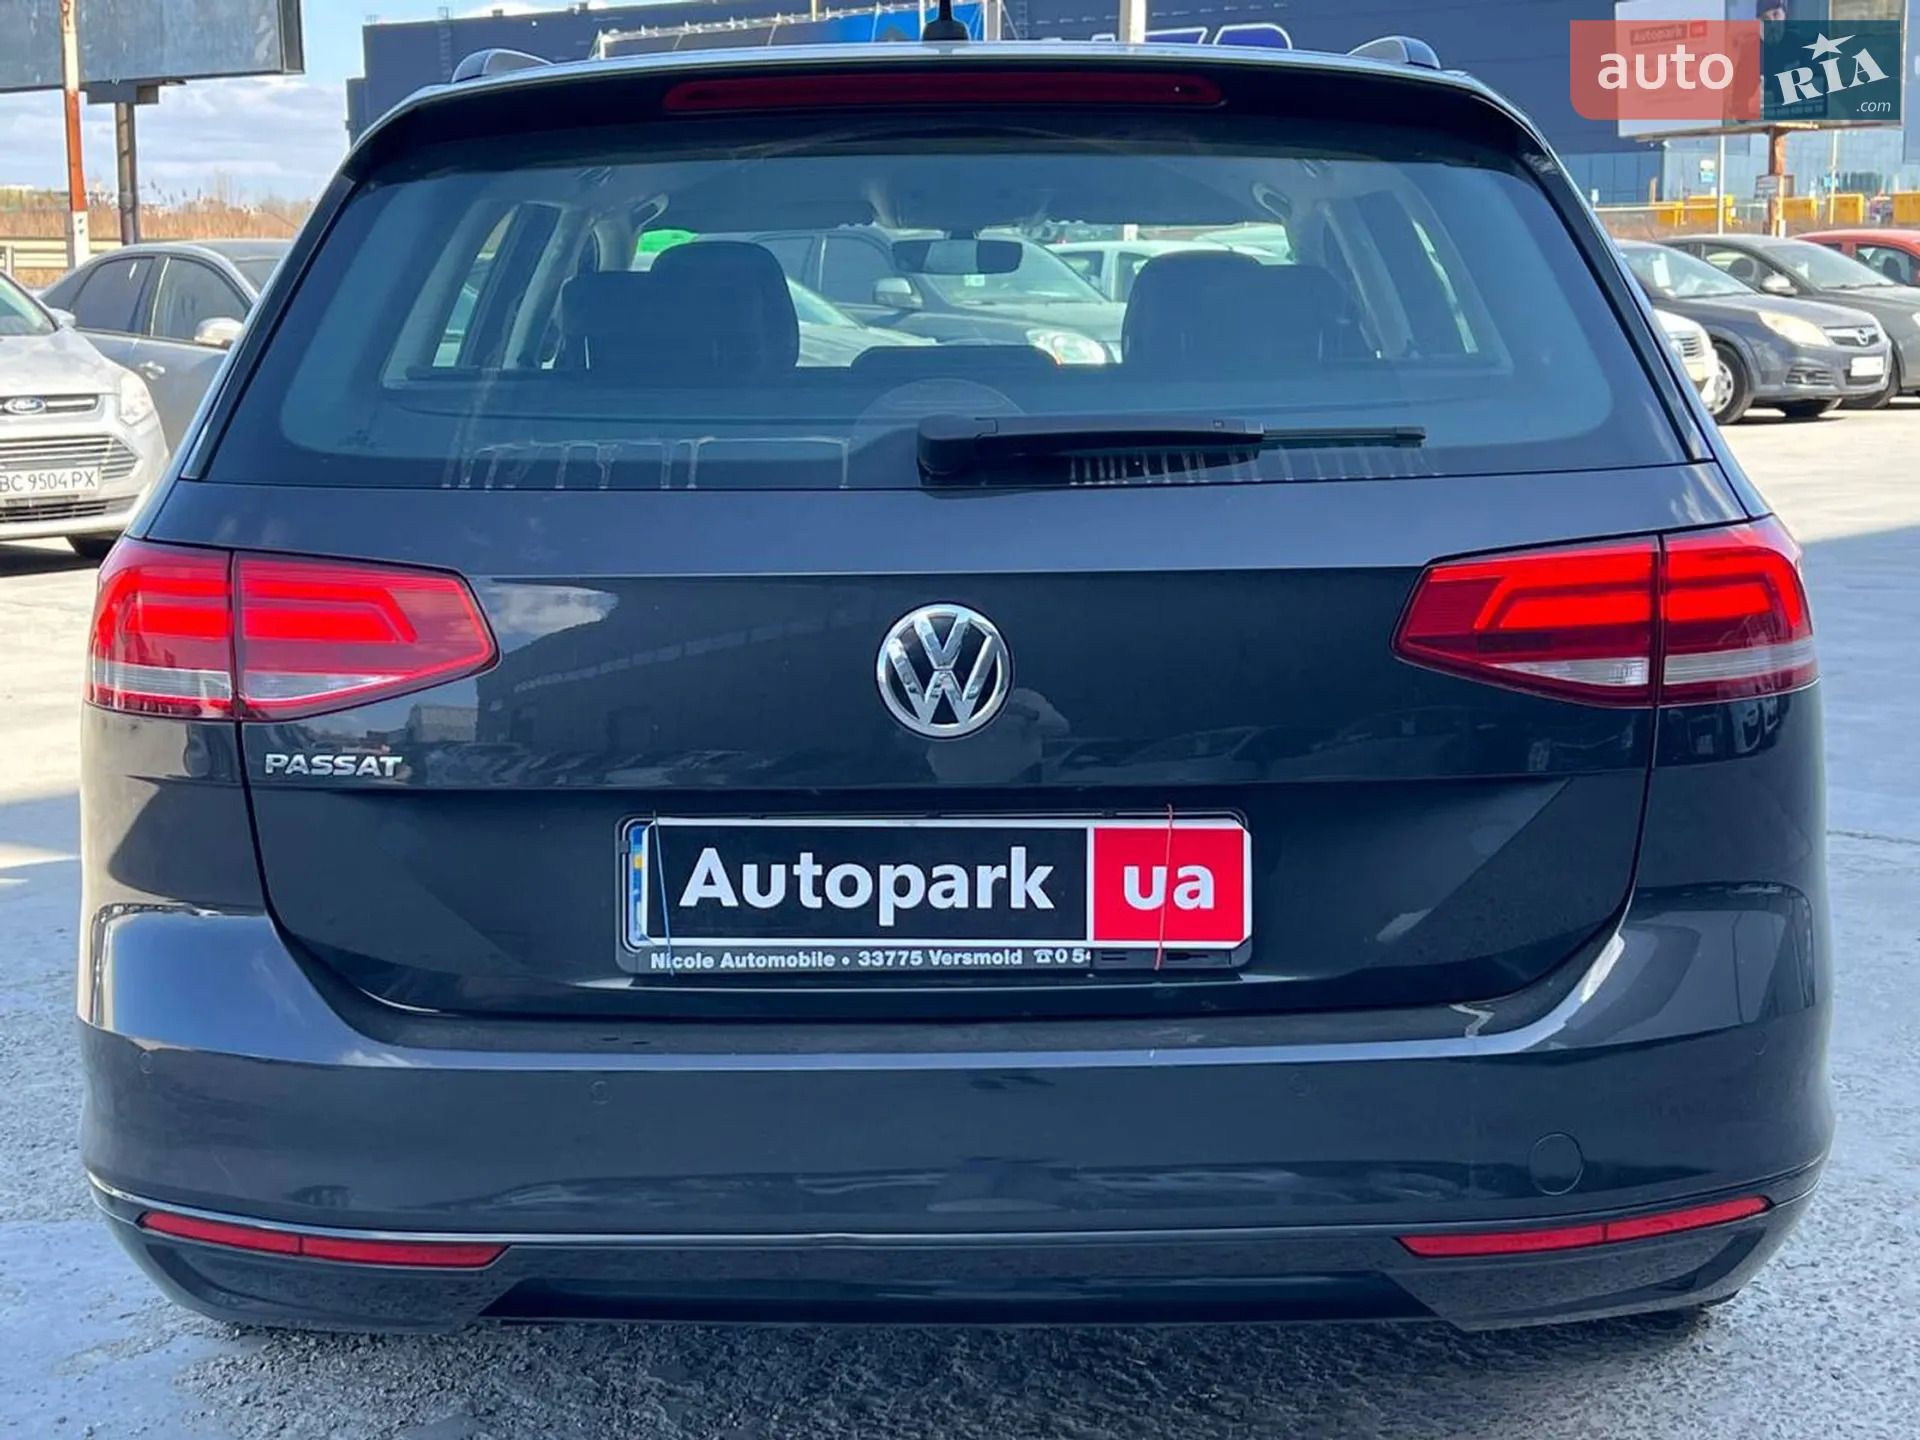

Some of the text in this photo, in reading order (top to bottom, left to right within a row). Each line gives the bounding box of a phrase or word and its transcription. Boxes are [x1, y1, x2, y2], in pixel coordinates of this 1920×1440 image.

[28, 472, 68, 491] 9504
[71, 470, 96, 489] PX
[265, 754, 403, 777] PASSAT
[679, 846, 1216, 927] Autopark ua
[650, 952, 715, 969] Nicole
[720, 951, 836, 969] Automobile
[857, 950, 923, 967] 33775
[928, 949, 1022, 966] Versmold
